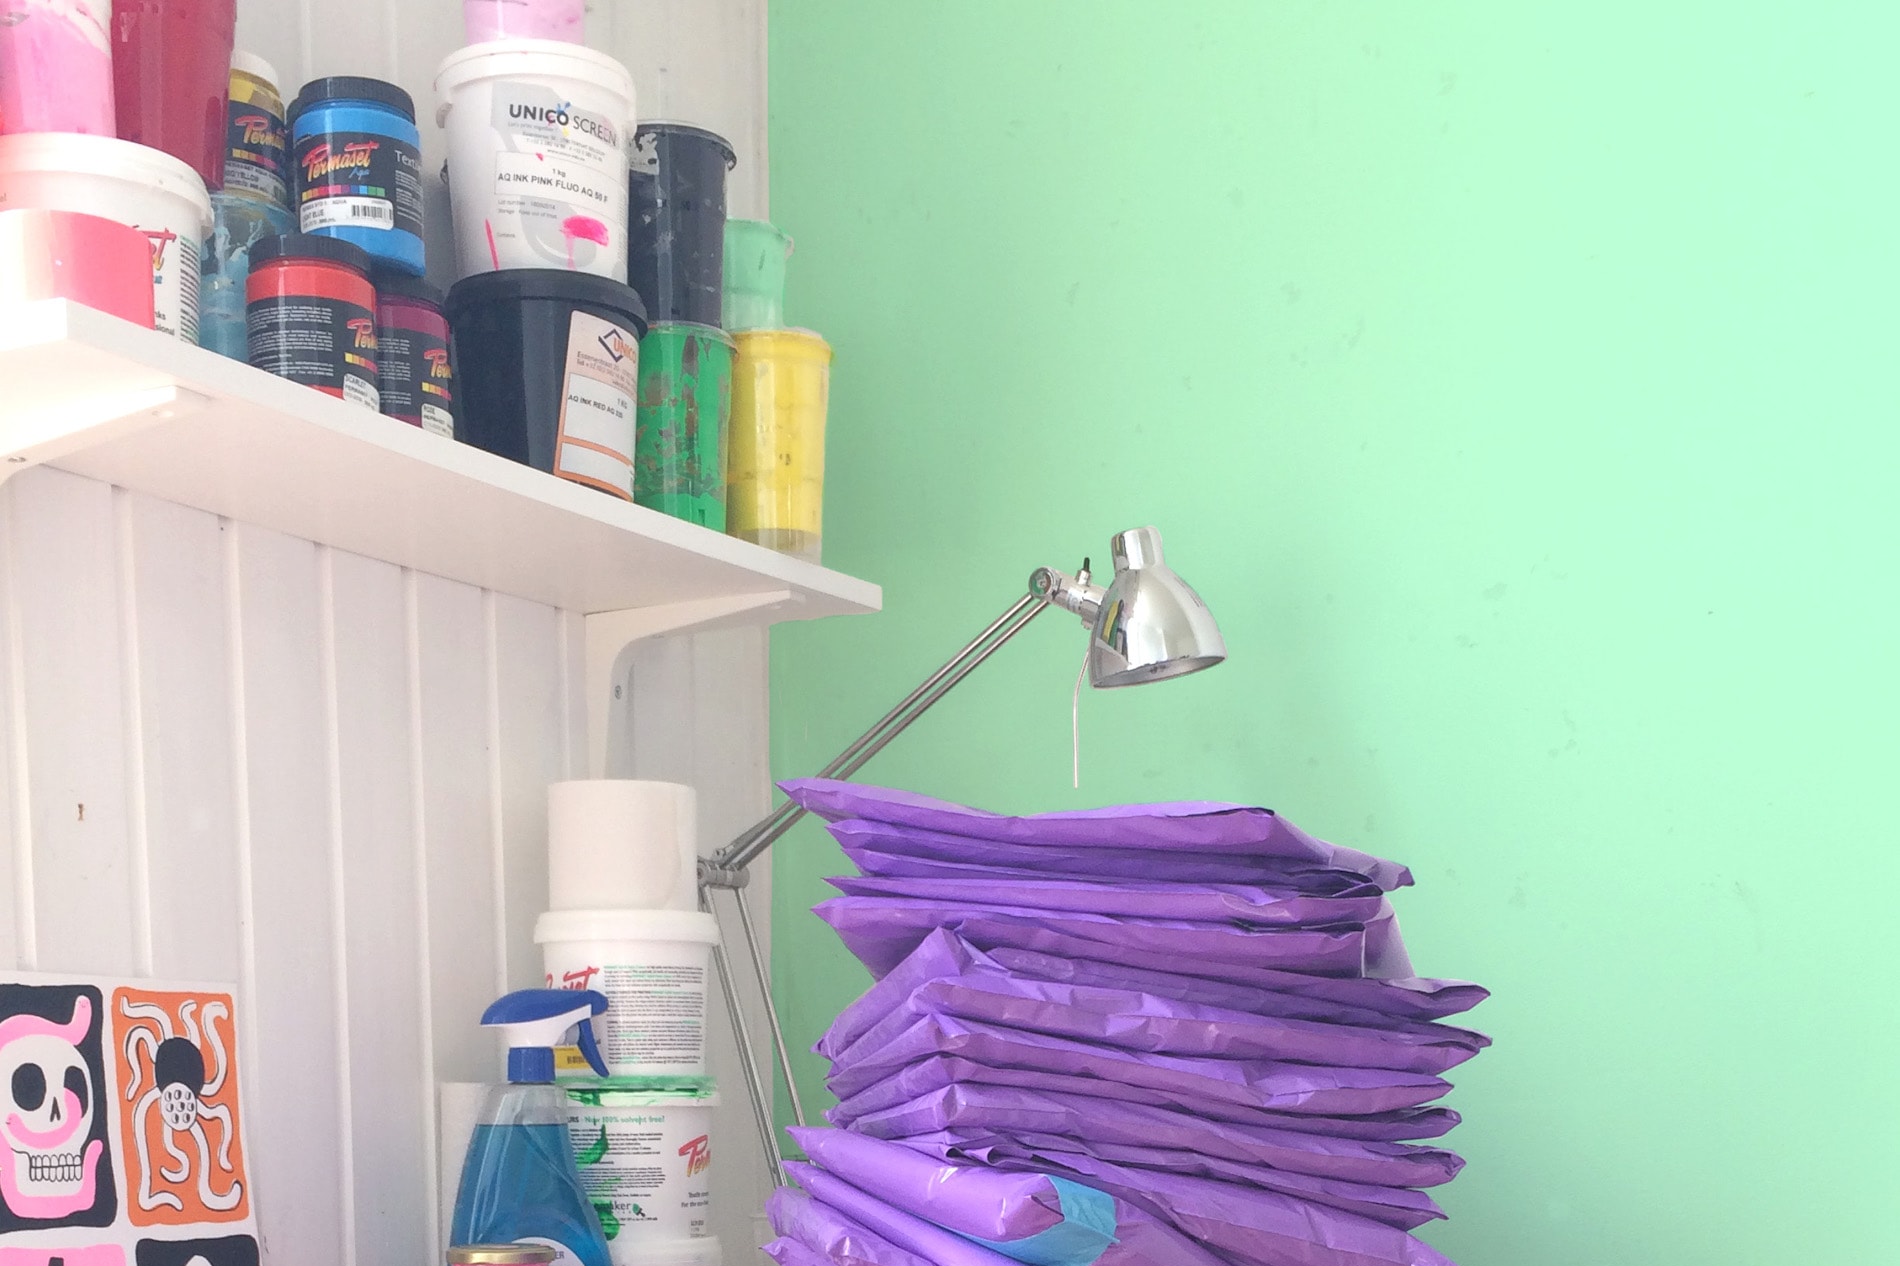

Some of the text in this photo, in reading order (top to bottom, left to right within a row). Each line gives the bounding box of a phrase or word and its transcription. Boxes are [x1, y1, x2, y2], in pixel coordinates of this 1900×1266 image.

[509, 103, 569, 126] UNICO
[573, 115, 617, 146] SCREEN
[302, 141, 379, 182] Permaset
[498, 173, 511, 182] AQ
[513, 173, 529, 183] INK
[531, 175, 553, 186] PINK
[555, 179, 579, 193] FLUO
[581, 187, 593, 198] AQ
[593, 401, 606, 411] RED
